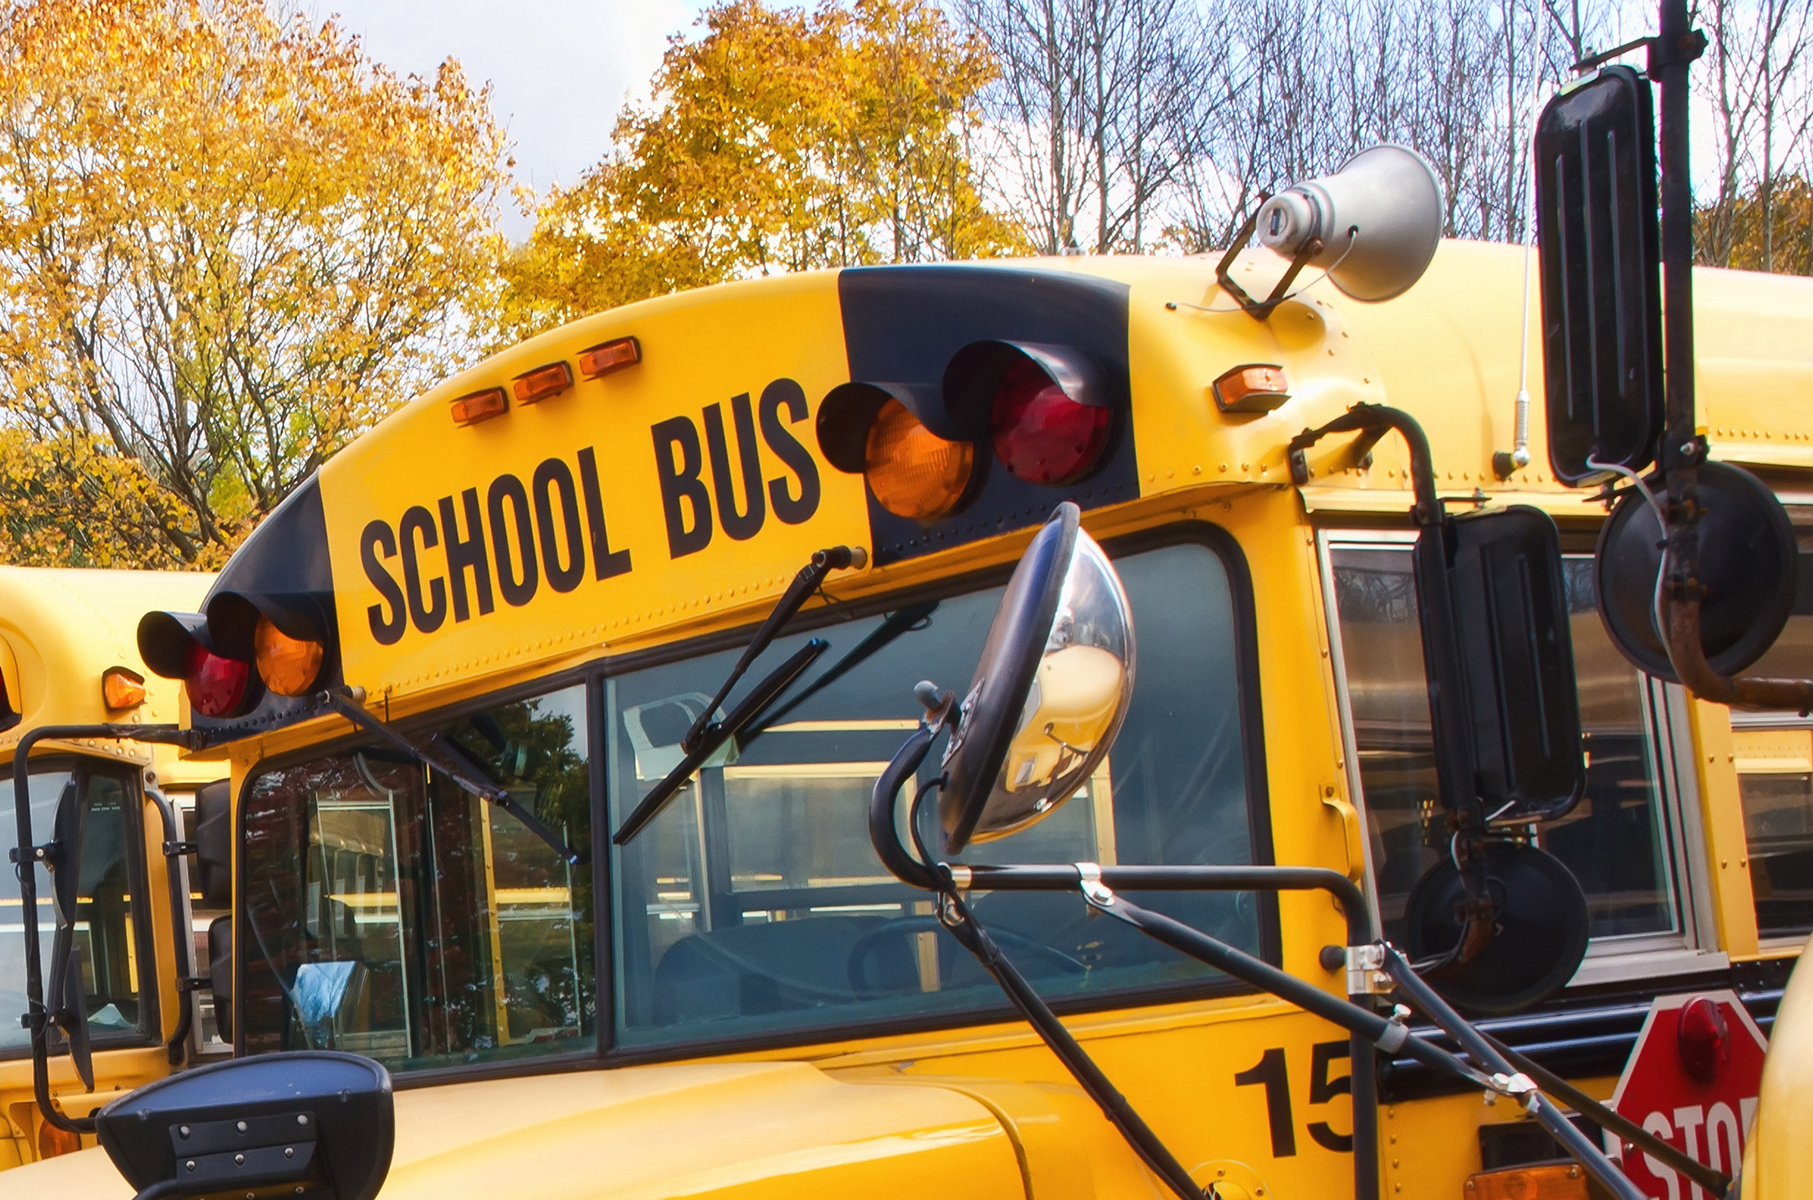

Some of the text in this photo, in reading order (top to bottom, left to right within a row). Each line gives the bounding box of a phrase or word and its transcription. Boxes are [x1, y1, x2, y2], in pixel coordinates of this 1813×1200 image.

[359, 377, 822, 646] SCHOOL BUS
[1234, 1039, 1355, 1159] 15
